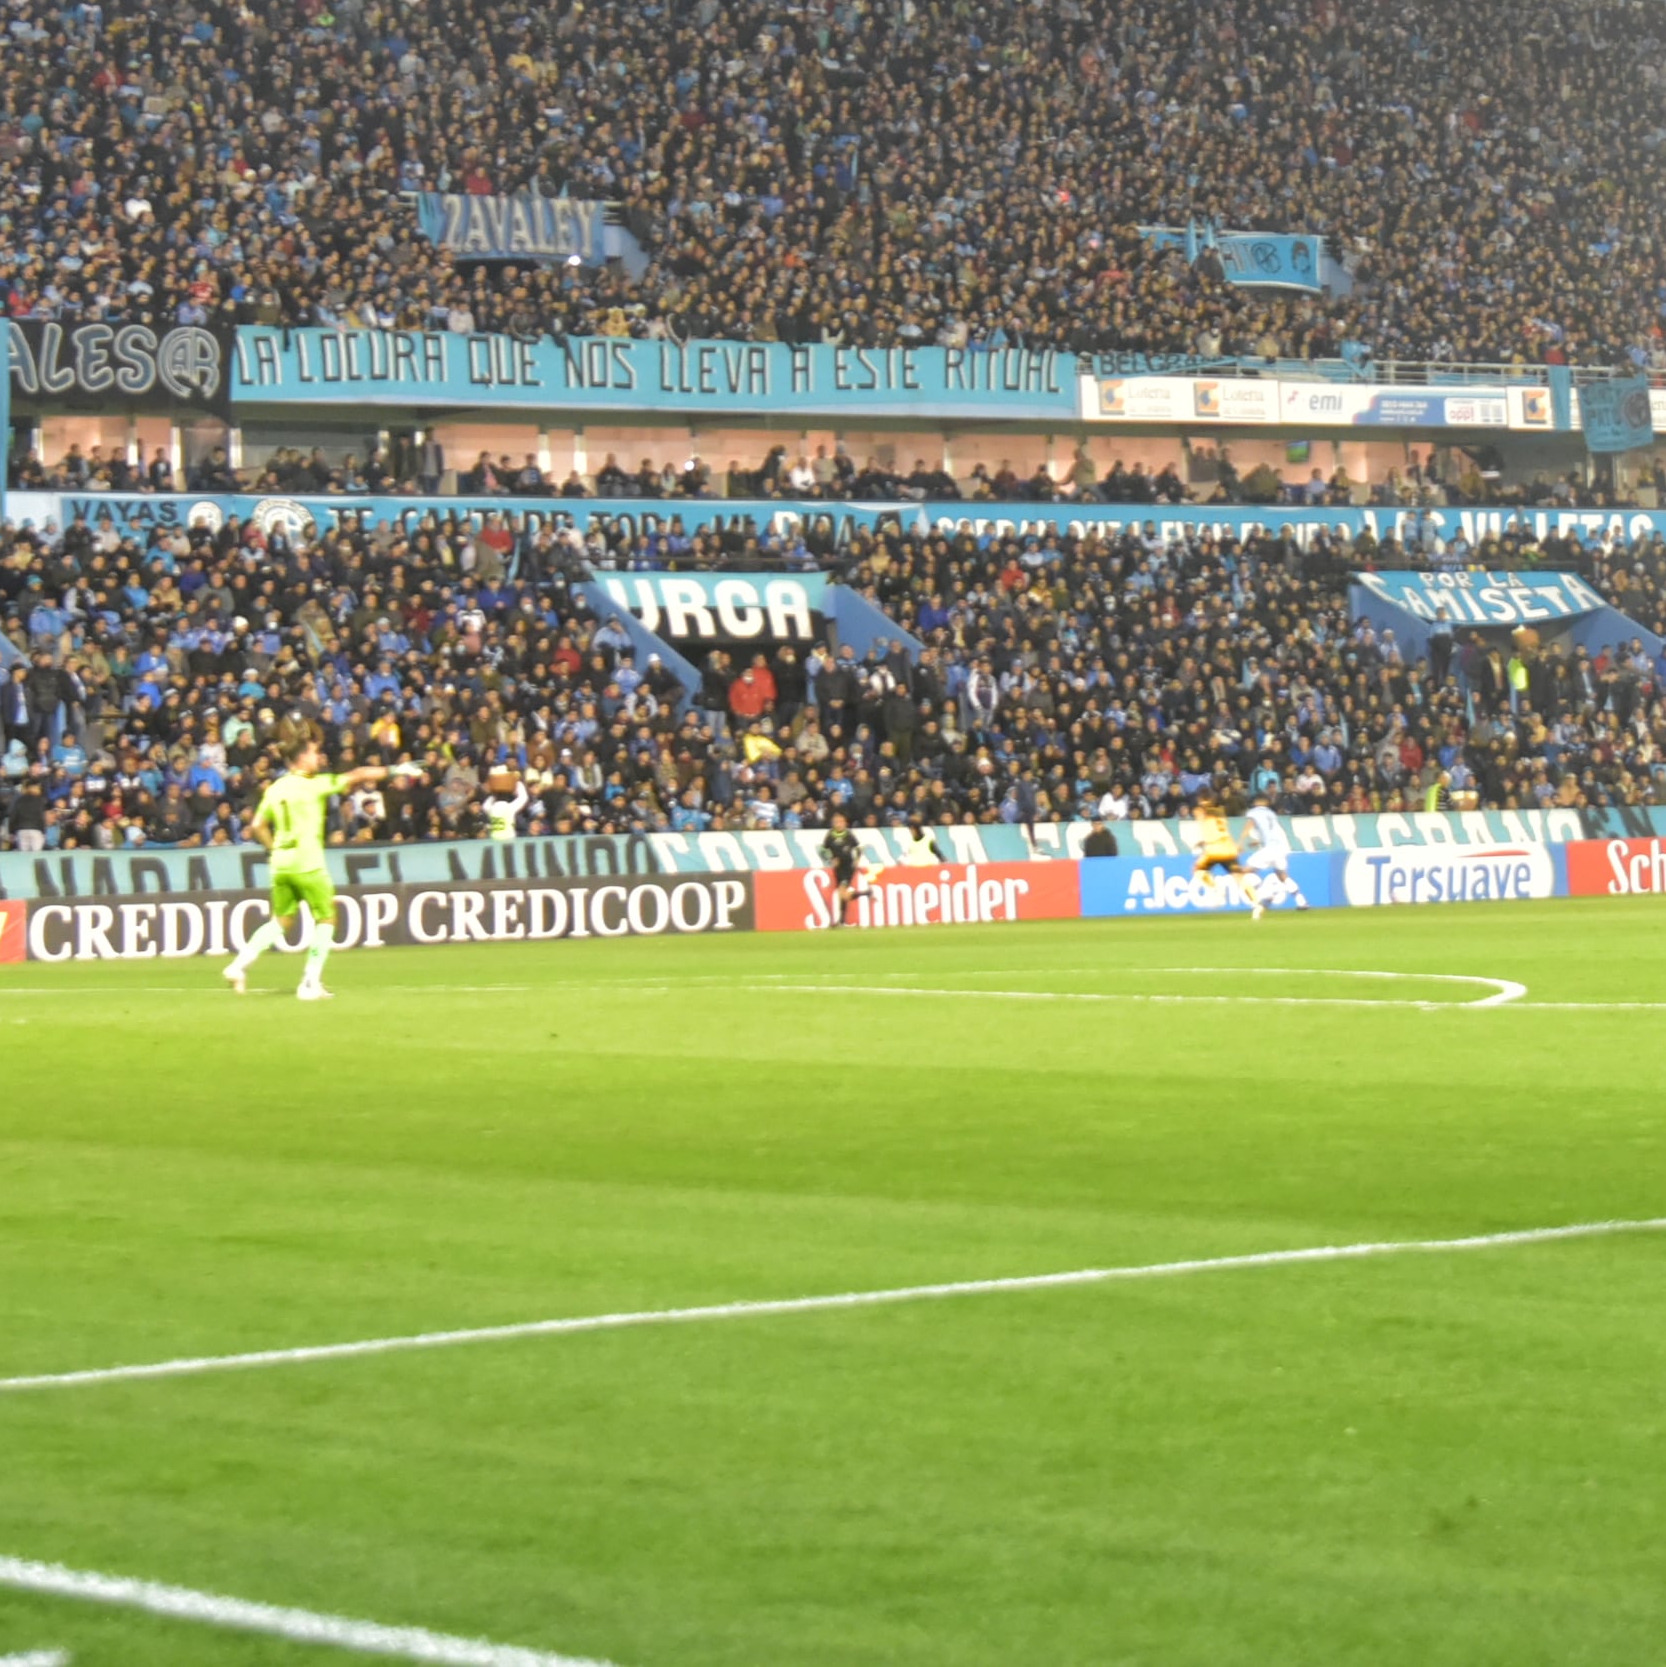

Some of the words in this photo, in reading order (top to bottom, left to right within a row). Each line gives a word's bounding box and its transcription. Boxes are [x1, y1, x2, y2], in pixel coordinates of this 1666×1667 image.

[235, 334, 282, 385] LA
[296, 332, 449, 383] LOCURA
[468, 335, 545, 388] QUE
[564, 338, 638, 390] NOS
[658, 343, 772, 394] LLEVA
[791, 345, 817, 392] A
[835, 346, 922, 391] ESTE
[944, 346, 1064, 394] RITUAL
[71, 500, 178, 523] VAYAS
[1357, 572, 1608, 622] CAMISETA
[1418, 572, 1475, 588] POR
[1486, 572, 1525, 588] LA
[606, 578, 814, 639] URCA
[803, 863, 1029, 931] Shneider
[1365, 854, 1532, 904] Tersuave
[407, 880, 746, 946] CREDICOOP
